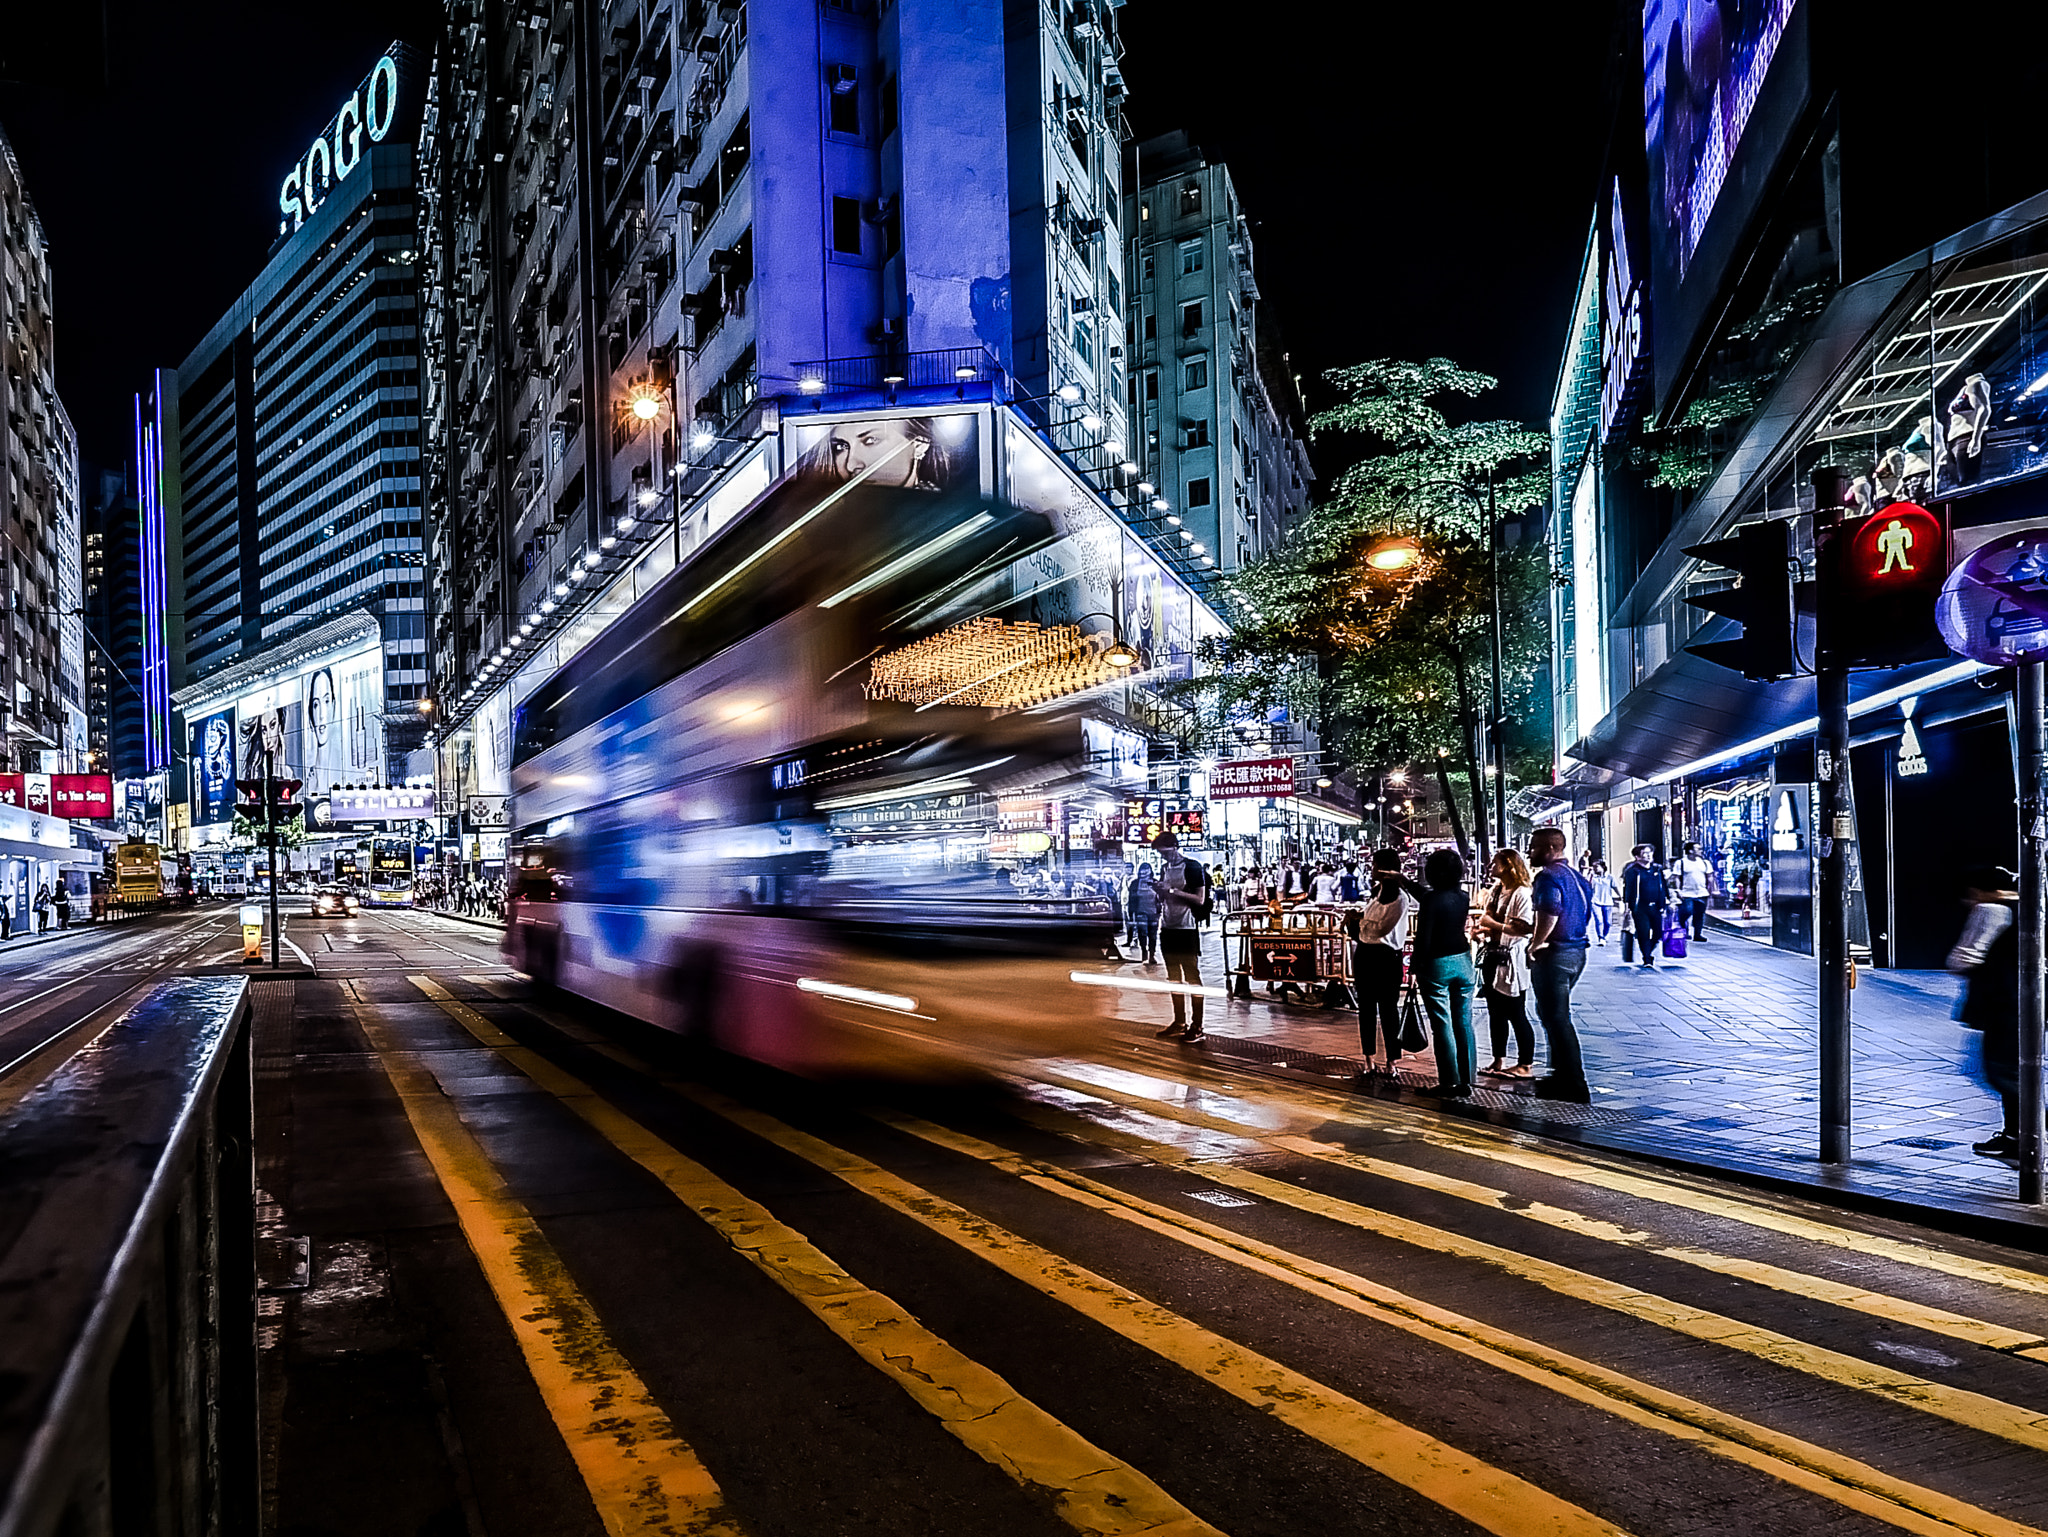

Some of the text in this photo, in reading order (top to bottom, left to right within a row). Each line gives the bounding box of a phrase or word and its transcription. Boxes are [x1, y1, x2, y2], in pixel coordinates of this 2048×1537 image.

[280, 56, 397, 235] SOGO
[1600, 289, 1641, 444] adidas
[1210, 764, 1293, 785] 許氏匯款中心
[56, 790, 68, 802] Eu
[69, 790, 85, 802] Yan
[340, 797, 379, 809] TSL
[911, 808, 963, 821] DISPENSARY
[1253, 942, 1312, 951] PEDESTRIANS
[1273, 965, 1295, 977] 行人
